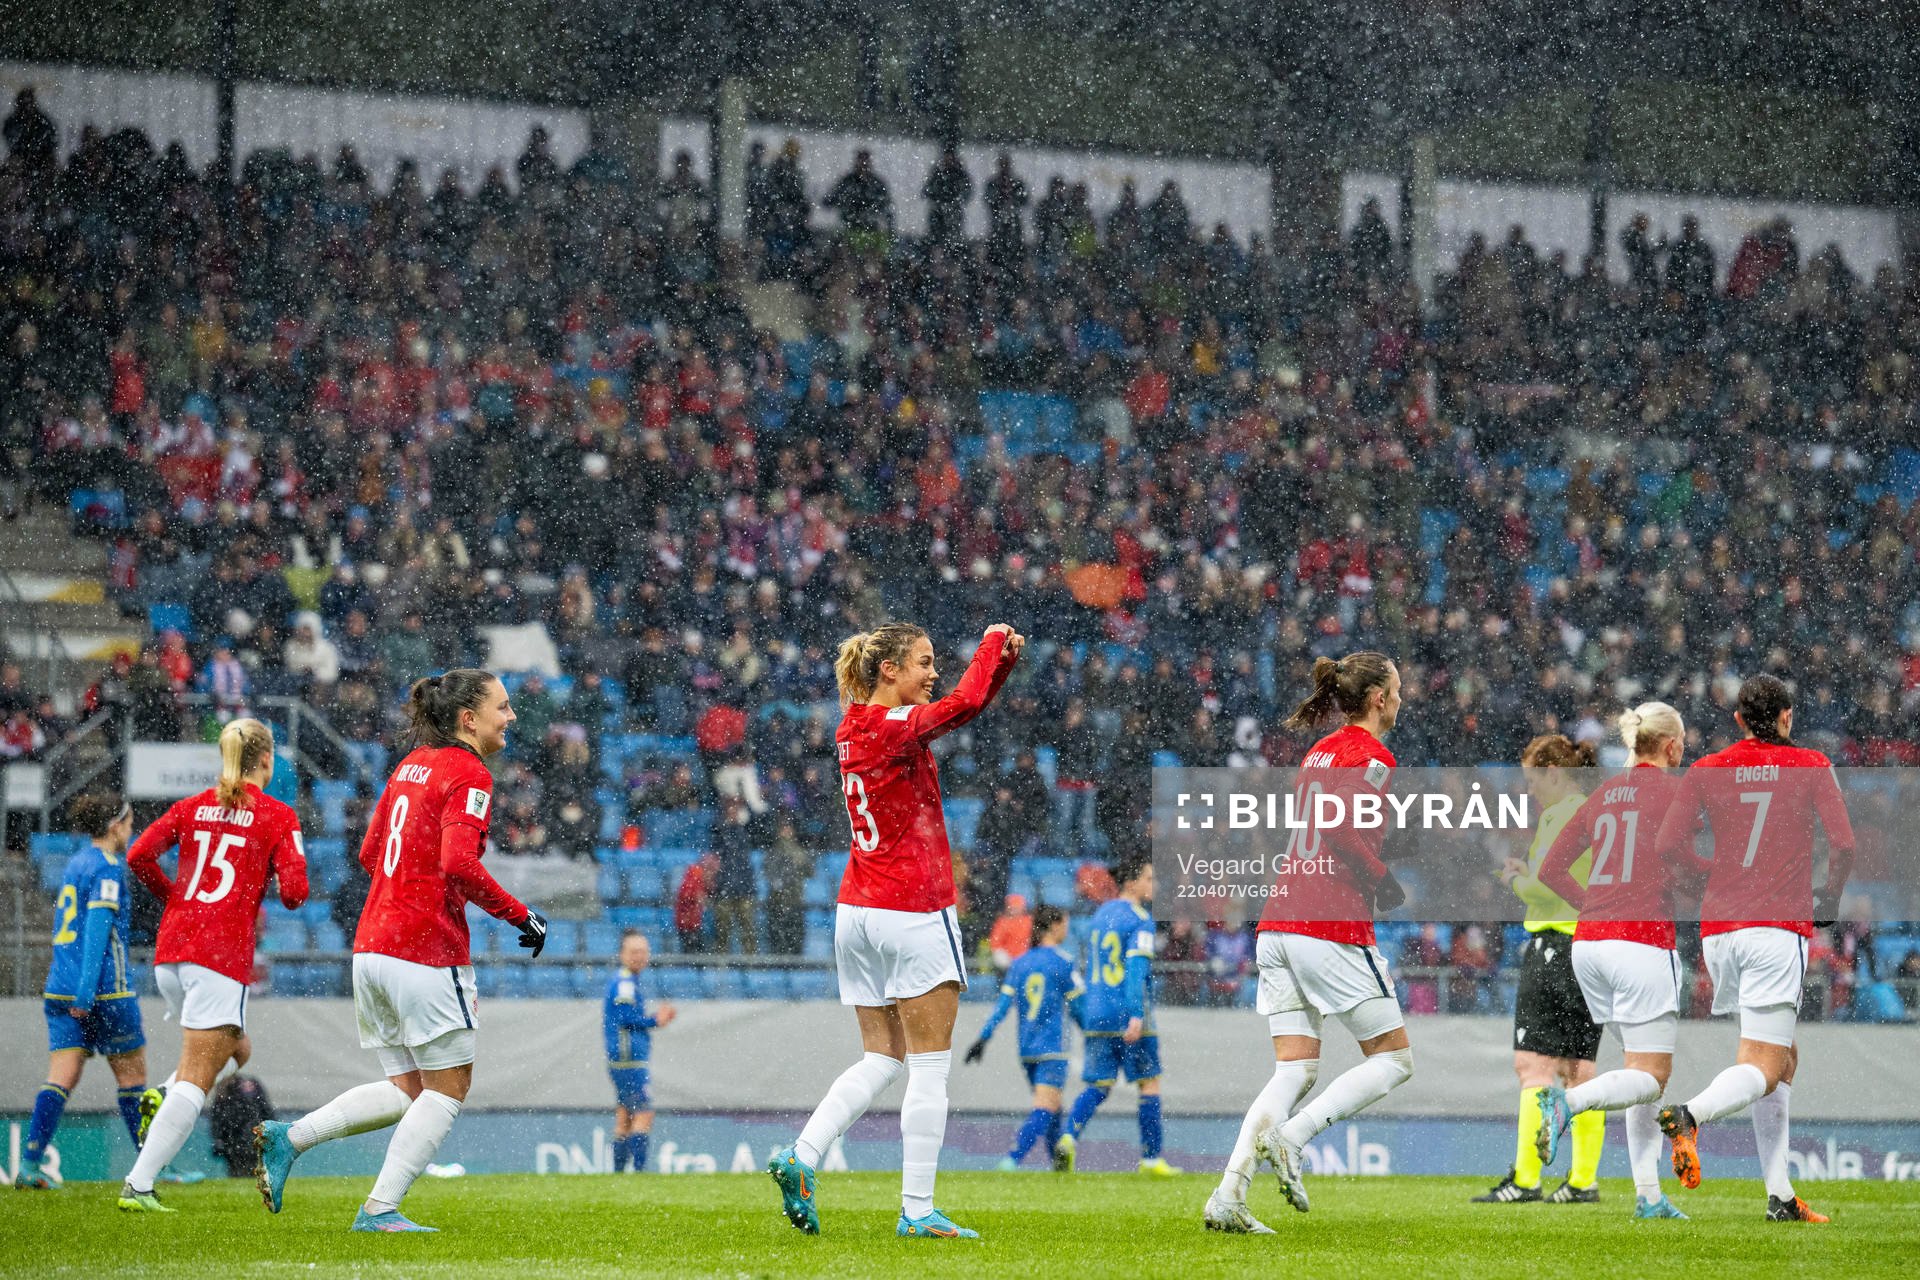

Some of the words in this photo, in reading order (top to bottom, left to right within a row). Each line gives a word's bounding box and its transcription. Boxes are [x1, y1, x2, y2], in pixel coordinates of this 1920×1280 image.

[1735, 764, 1780, 784] ENGEN
[194, 805, 254, 828] EIKELAND
[383, 794, 409, 878] 8
[1740, 791, 1773, 868] 7
[183, 830, 247, 904] 15
[1588, 811, 1639, 886] 21
[53, 884, 78, 945] 2
[1091, 930, 1125, 988] 13
[1025, 972, 1045, 1022] 9
